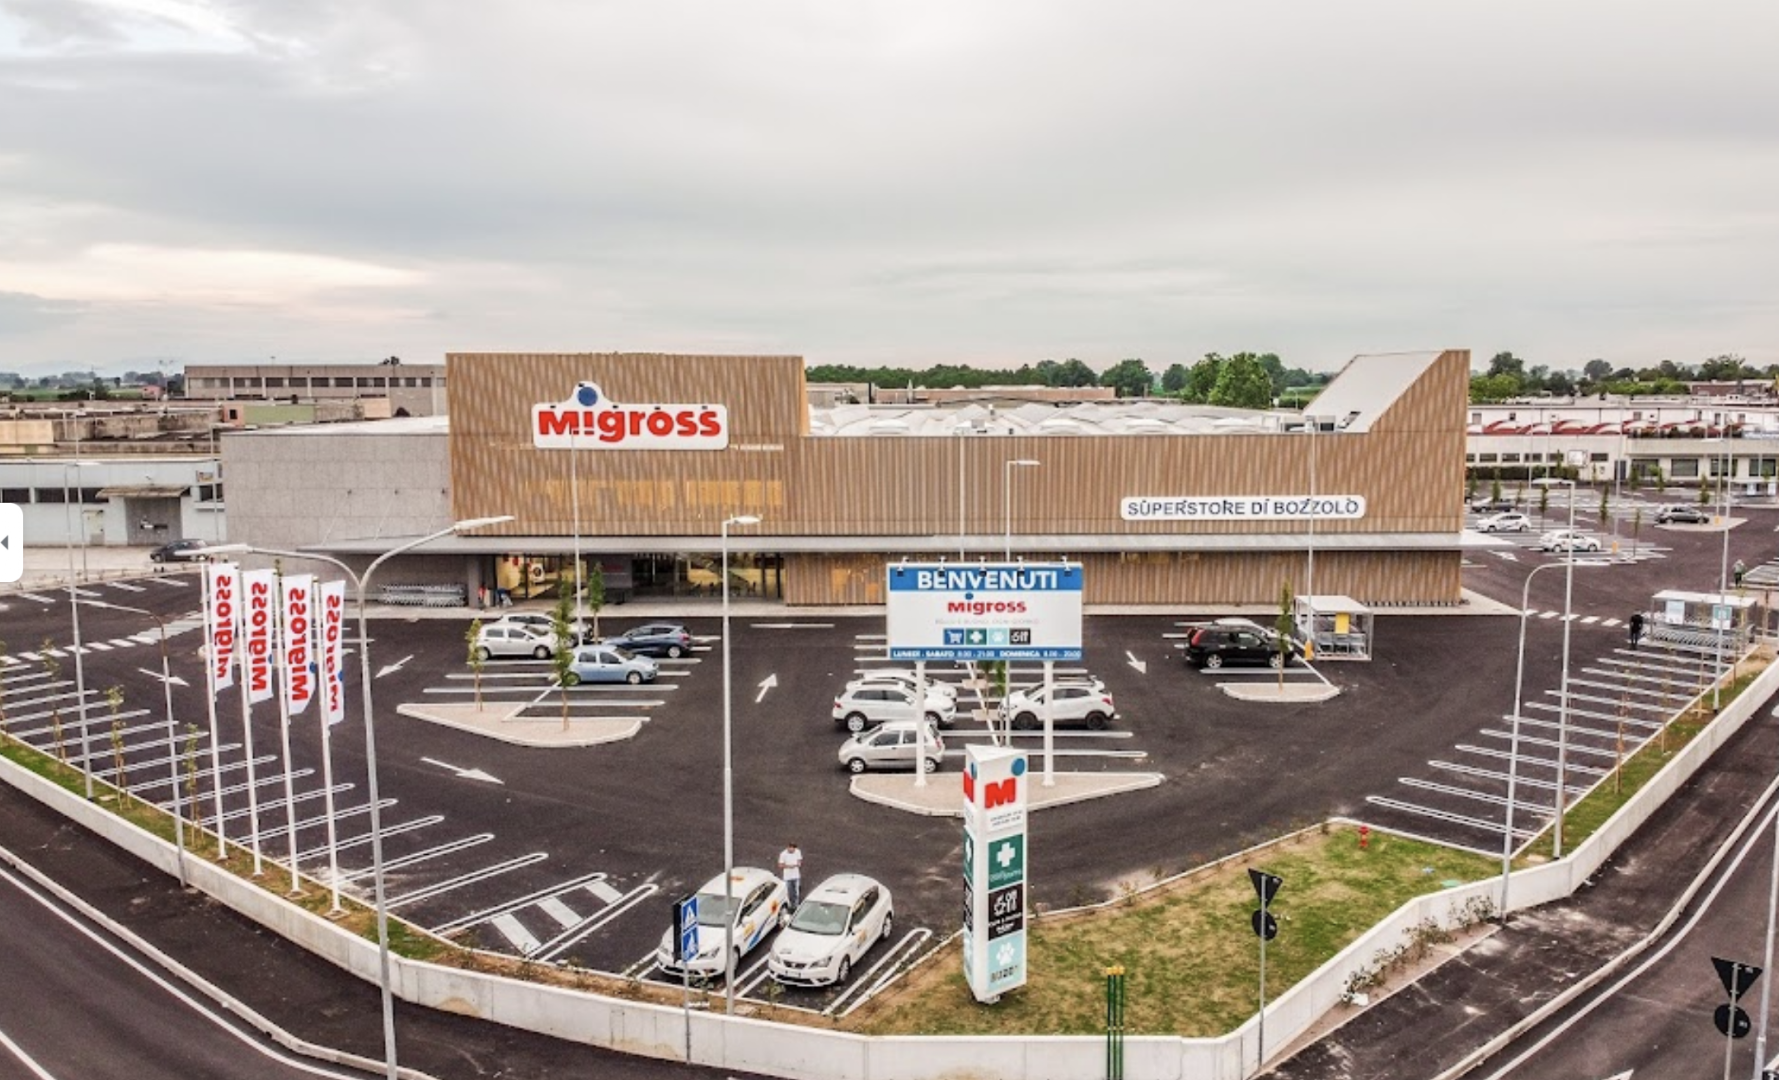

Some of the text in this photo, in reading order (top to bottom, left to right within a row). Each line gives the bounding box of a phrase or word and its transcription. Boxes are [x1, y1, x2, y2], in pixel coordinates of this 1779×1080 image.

[538, 387, 722, 443] Migross
[1127, 498, 1360, 517] SUPERSTORE DI BOZZOLO
[917, 570, 1058, 590] BENVENUTI
[947, 592, 1027, 616] Migross
